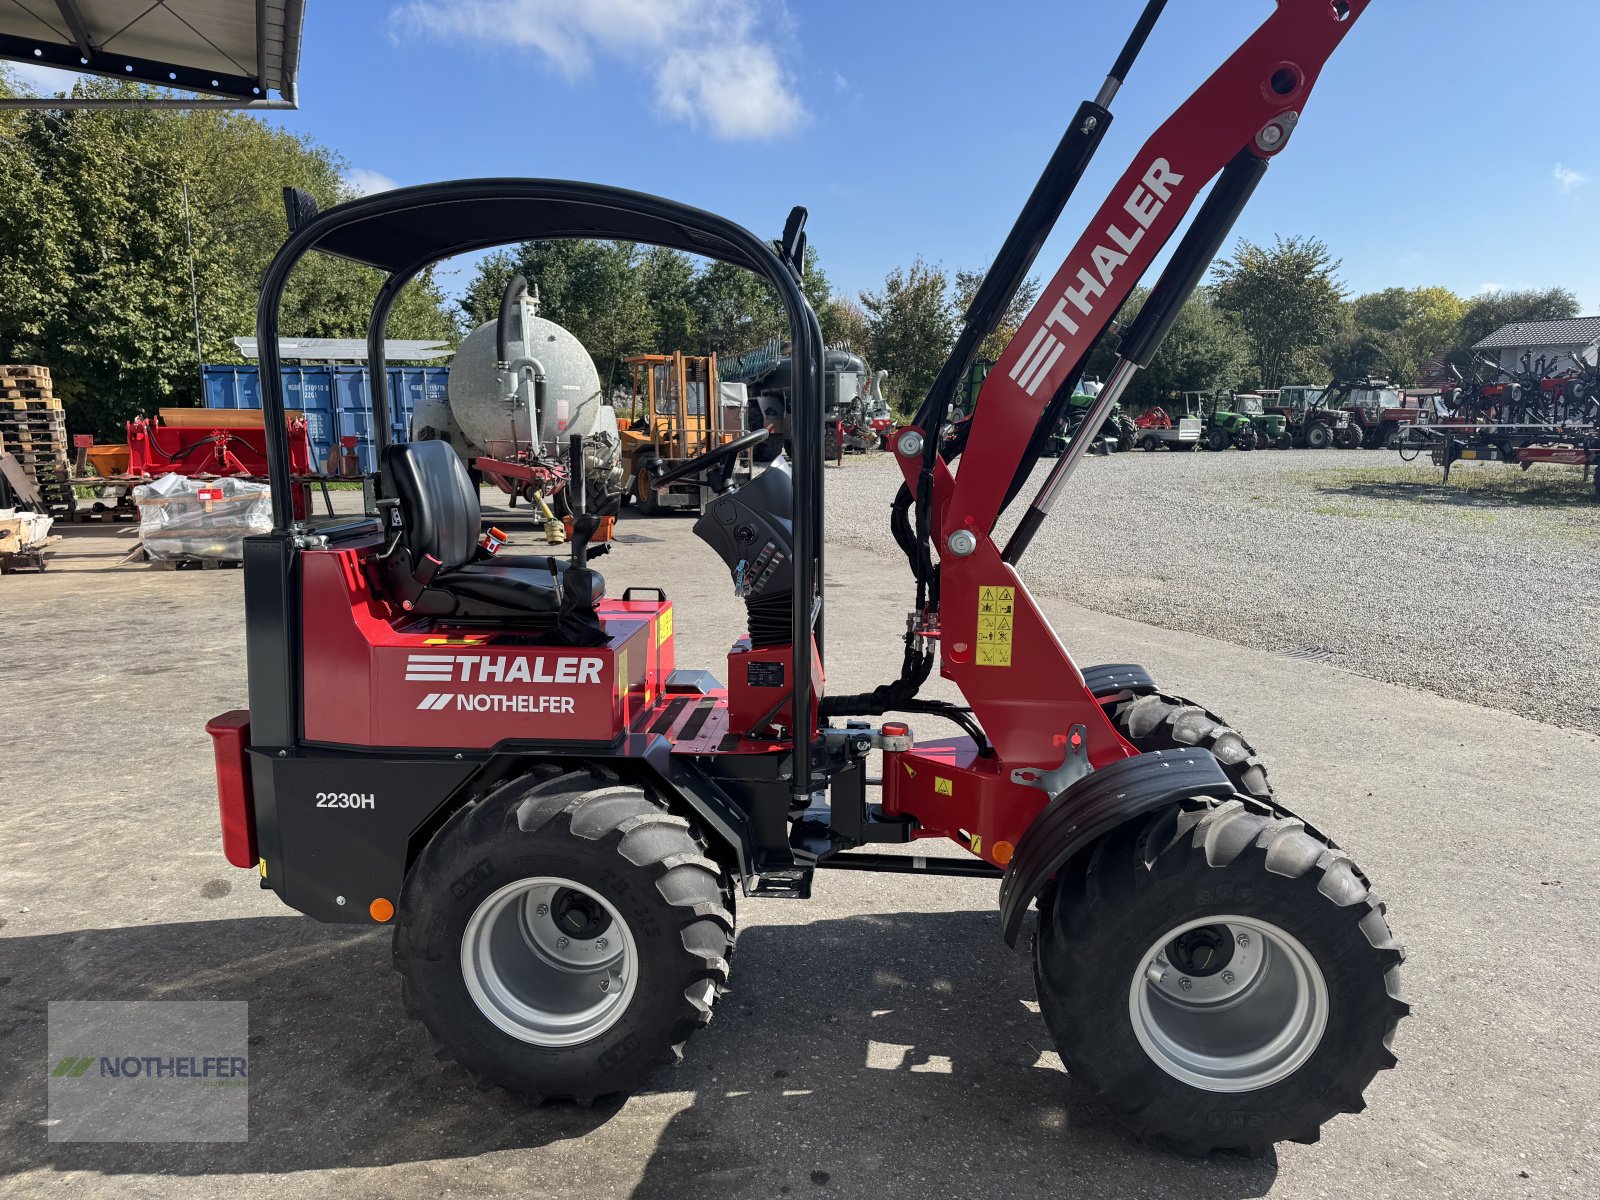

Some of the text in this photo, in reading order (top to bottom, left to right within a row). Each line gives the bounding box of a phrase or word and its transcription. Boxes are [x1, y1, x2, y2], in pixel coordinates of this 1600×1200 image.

[1046, 156, 1185, 337] THALER
[455, 655, 604, 684] THALER
[456, 694, 575, 714] NOTHELFER
[316, 792, 375, 809] 2230H
